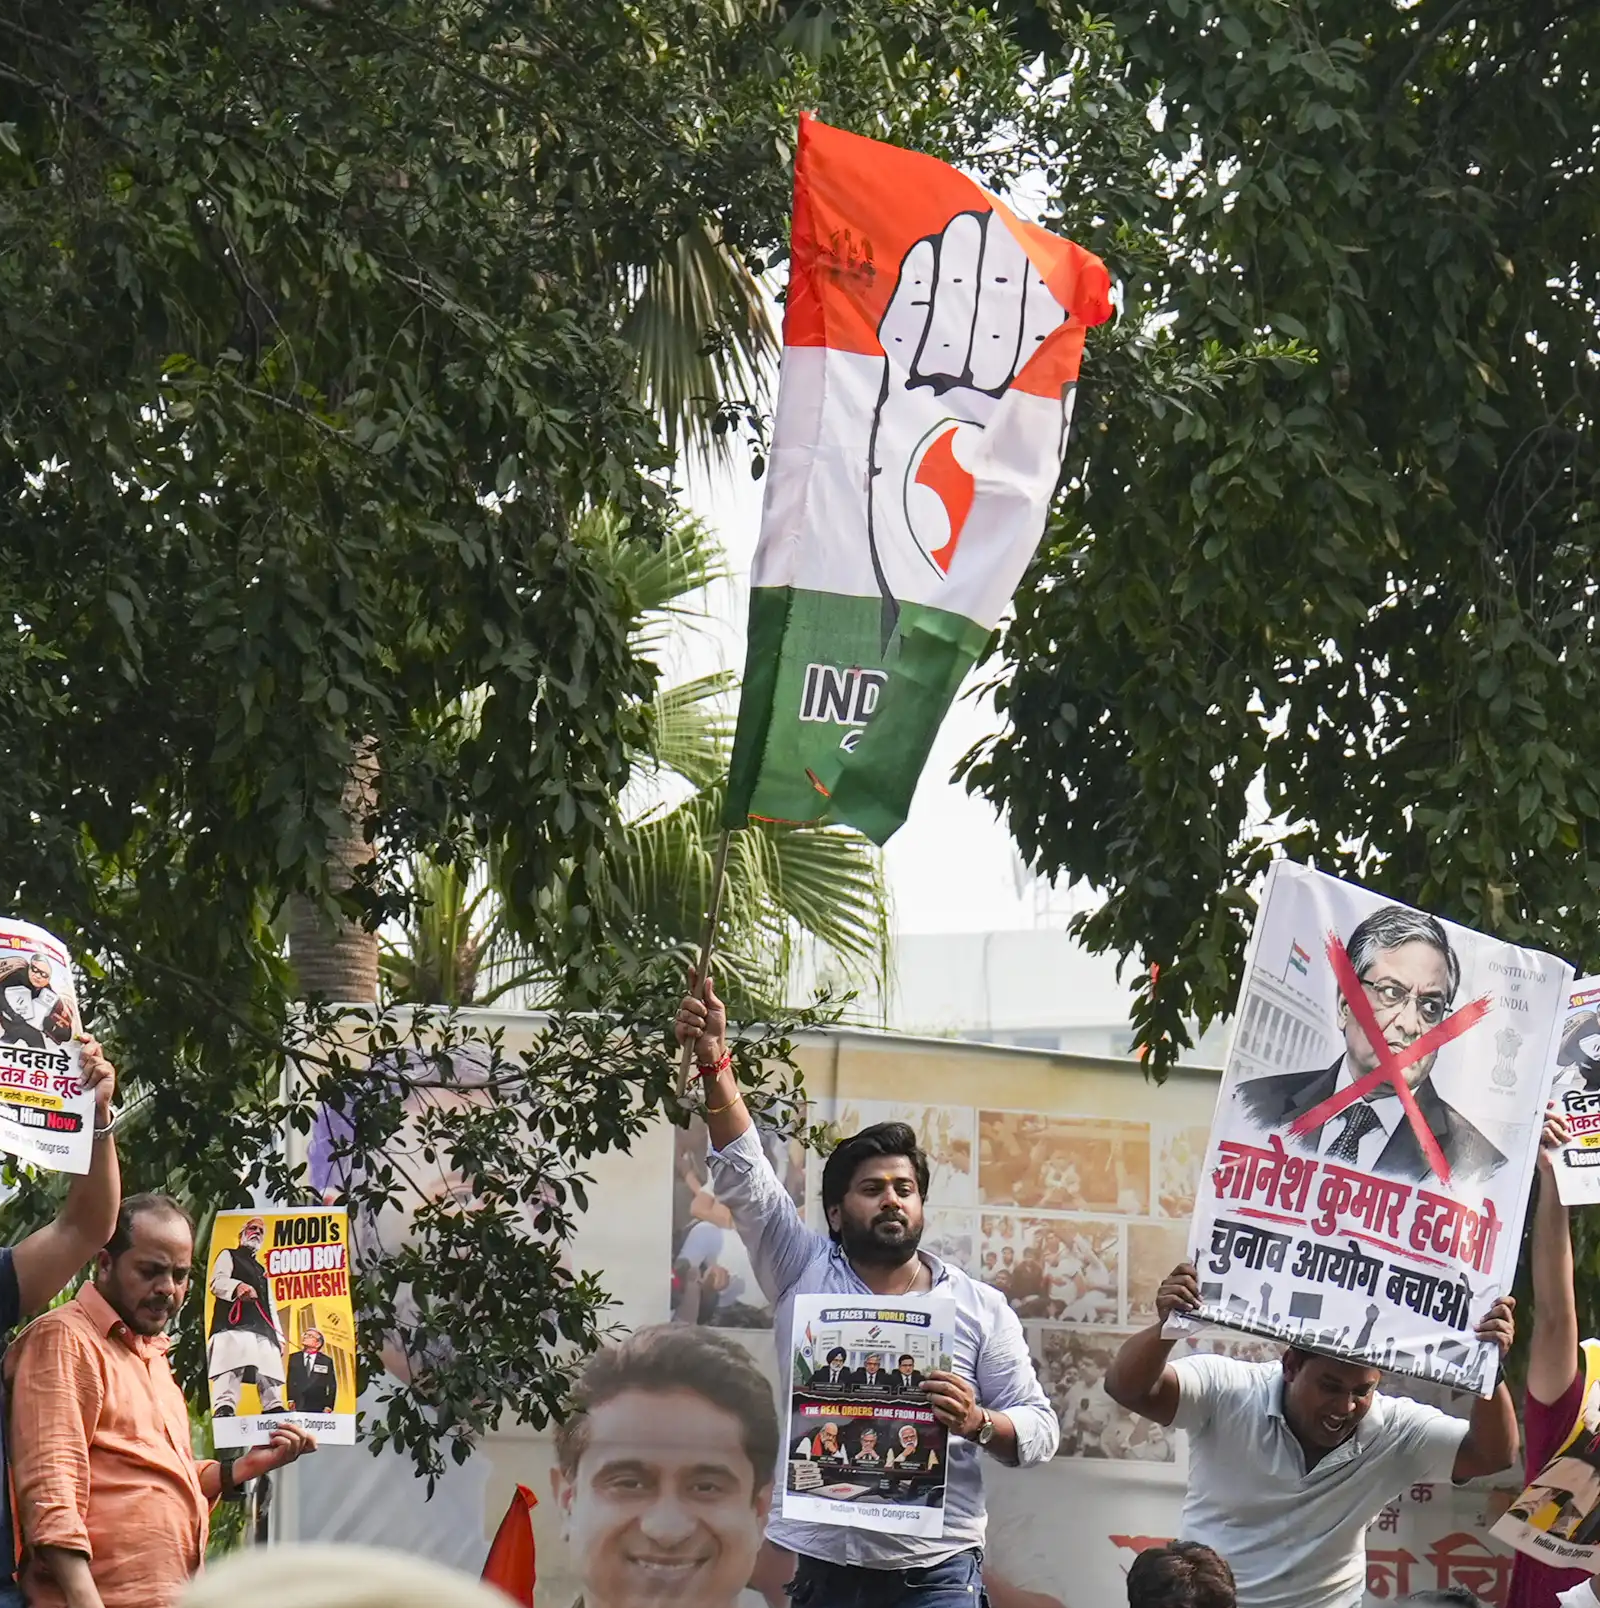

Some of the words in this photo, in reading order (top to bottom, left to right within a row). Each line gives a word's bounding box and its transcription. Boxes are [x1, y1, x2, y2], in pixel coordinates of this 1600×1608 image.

[10, 938, 21, 949] 10
[1488, 961, 1548, 984] CONSTITUTION
[1511, 984, 1522, 992] OF
[1500, 995, 1529, 1012] INDIA
[1572, 996, 1584, 1007] 10
[30, 1067, 49, 1088] की
[19, 1107, 45, 1127] Him
[47, 1112, 77, 1131] Now
[1212, 1134, 1318, 1213] ज्ञानेश
[1311, 1163, 1411, 1237] कुमार
[1409, 1188, 1503, 1275] हटाओ
[269, 1247, 312, 1275] GOOD
[313, 1244, 344, 1270] BOY
[1209, 1218, 1292, 1275] चुनाव
[1291, 1238, 1384, 1297] आयोग
[1386, 1263, 1473, 1331] बचाओ
[275, 1271, 347, 1301] GYANESH!
[826, 1311, 839, 1320] THE
[840, 1310, 864, 1320] FACES
[864, 1311, 877, 1320] THE
[877, 1311, 905, 1322] WORLD
[905, 1313, 925, 1325] SEES
[805, 1406, 819, 1415] THE
[820, 1406, 840, 1416] REAL
[841, 1407, 873, 1416] ORDERS
[874, 1408, 894, 1419] CAME
[894, 1410, 915, 1420] FROM
[916, 1412, 934, 1422] HERE
[257, 1419, 278, 1432] India
[304, 1418, 336, 1431] Congress
[830, 1503, 855, 1513] Indian
[857, 1505, 880, 1516] Youth
[881, 1507, 920, 1520] Congress
[1532, 1535, 1557, 1551] Indian
